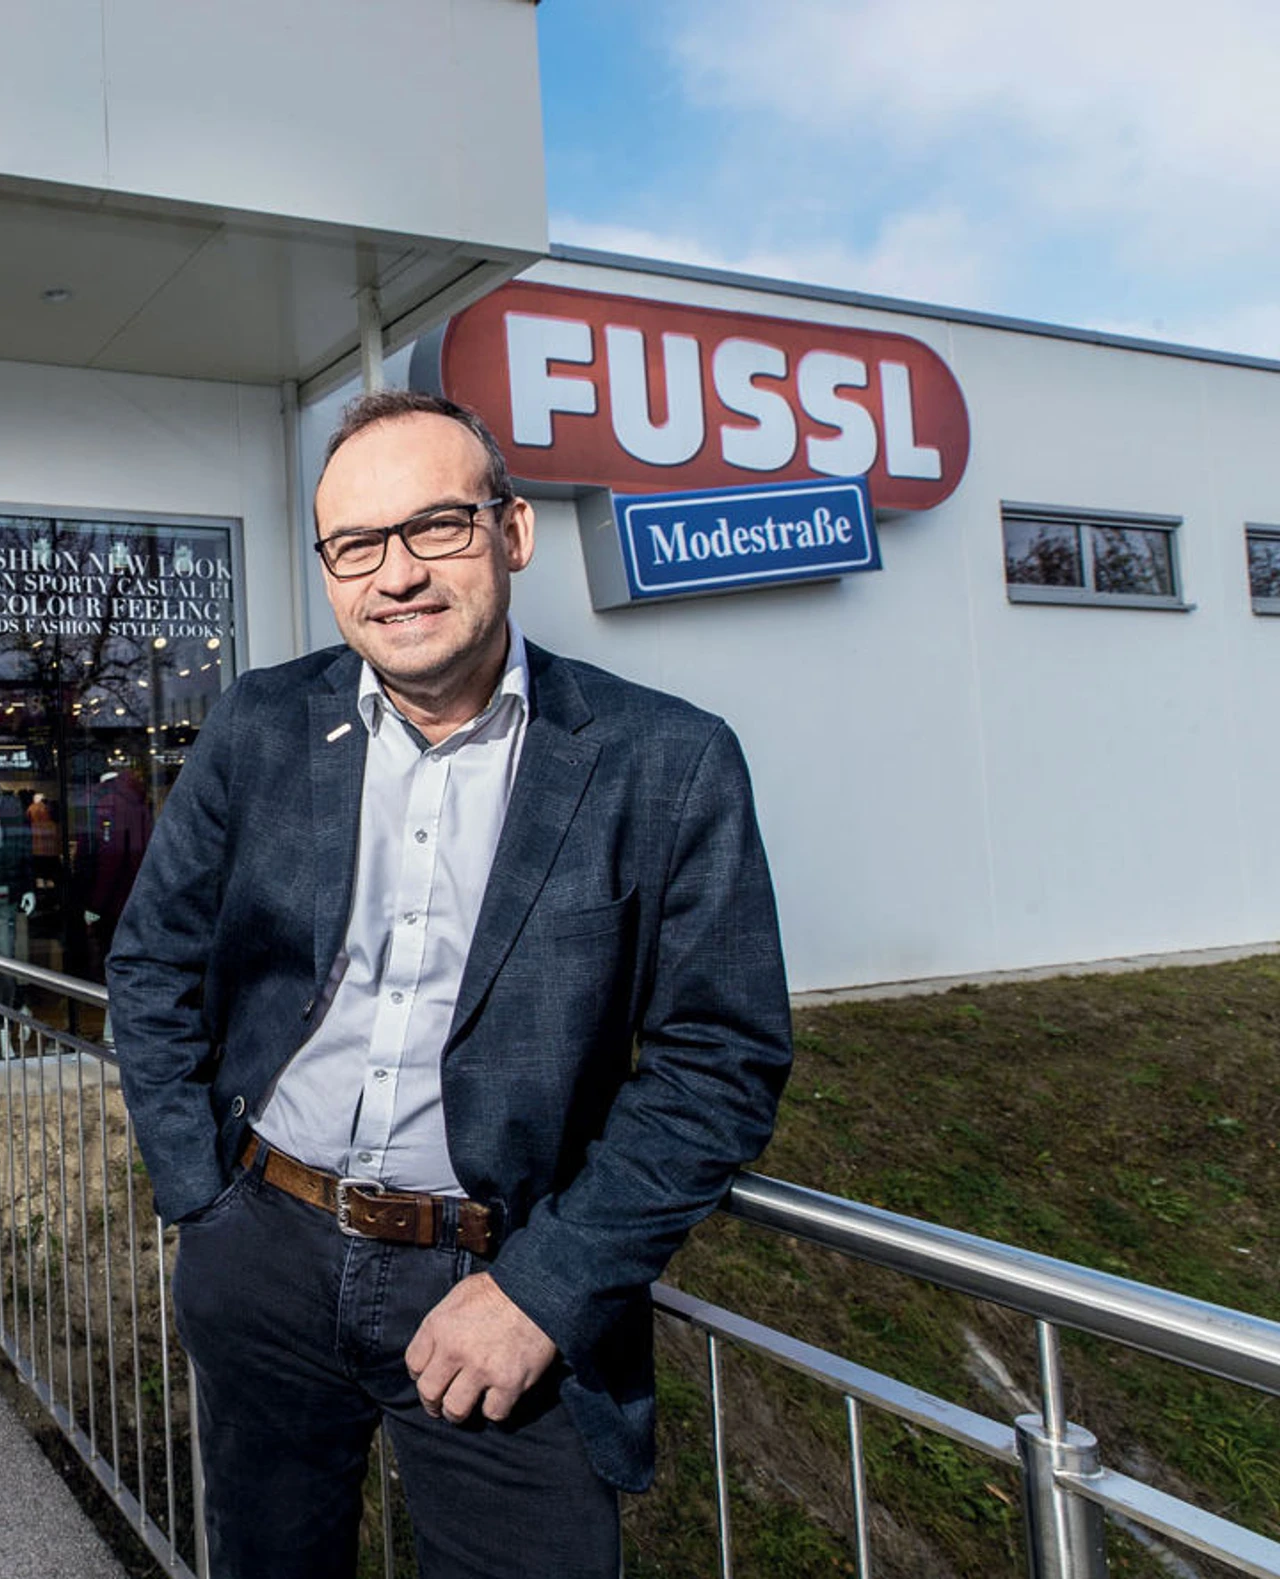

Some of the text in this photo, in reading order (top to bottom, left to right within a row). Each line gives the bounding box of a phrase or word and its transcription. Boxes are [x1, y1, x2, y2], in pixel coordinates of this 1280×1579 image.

[505, 310, 943, 481] FUSSL
[649, 506, 853, 565] Modestraße
[89, 552, 150, 576] NEW
[24, 573, 109, 595] SPORTY
[117, 577, 204, 599] CASUAL
[112, 598, 220, 620] FEELING
[25, 619, 103, 635] FASHION
[109, 622, 162, 636] STYLE
[169, 623, 224, 638] LOOKS
